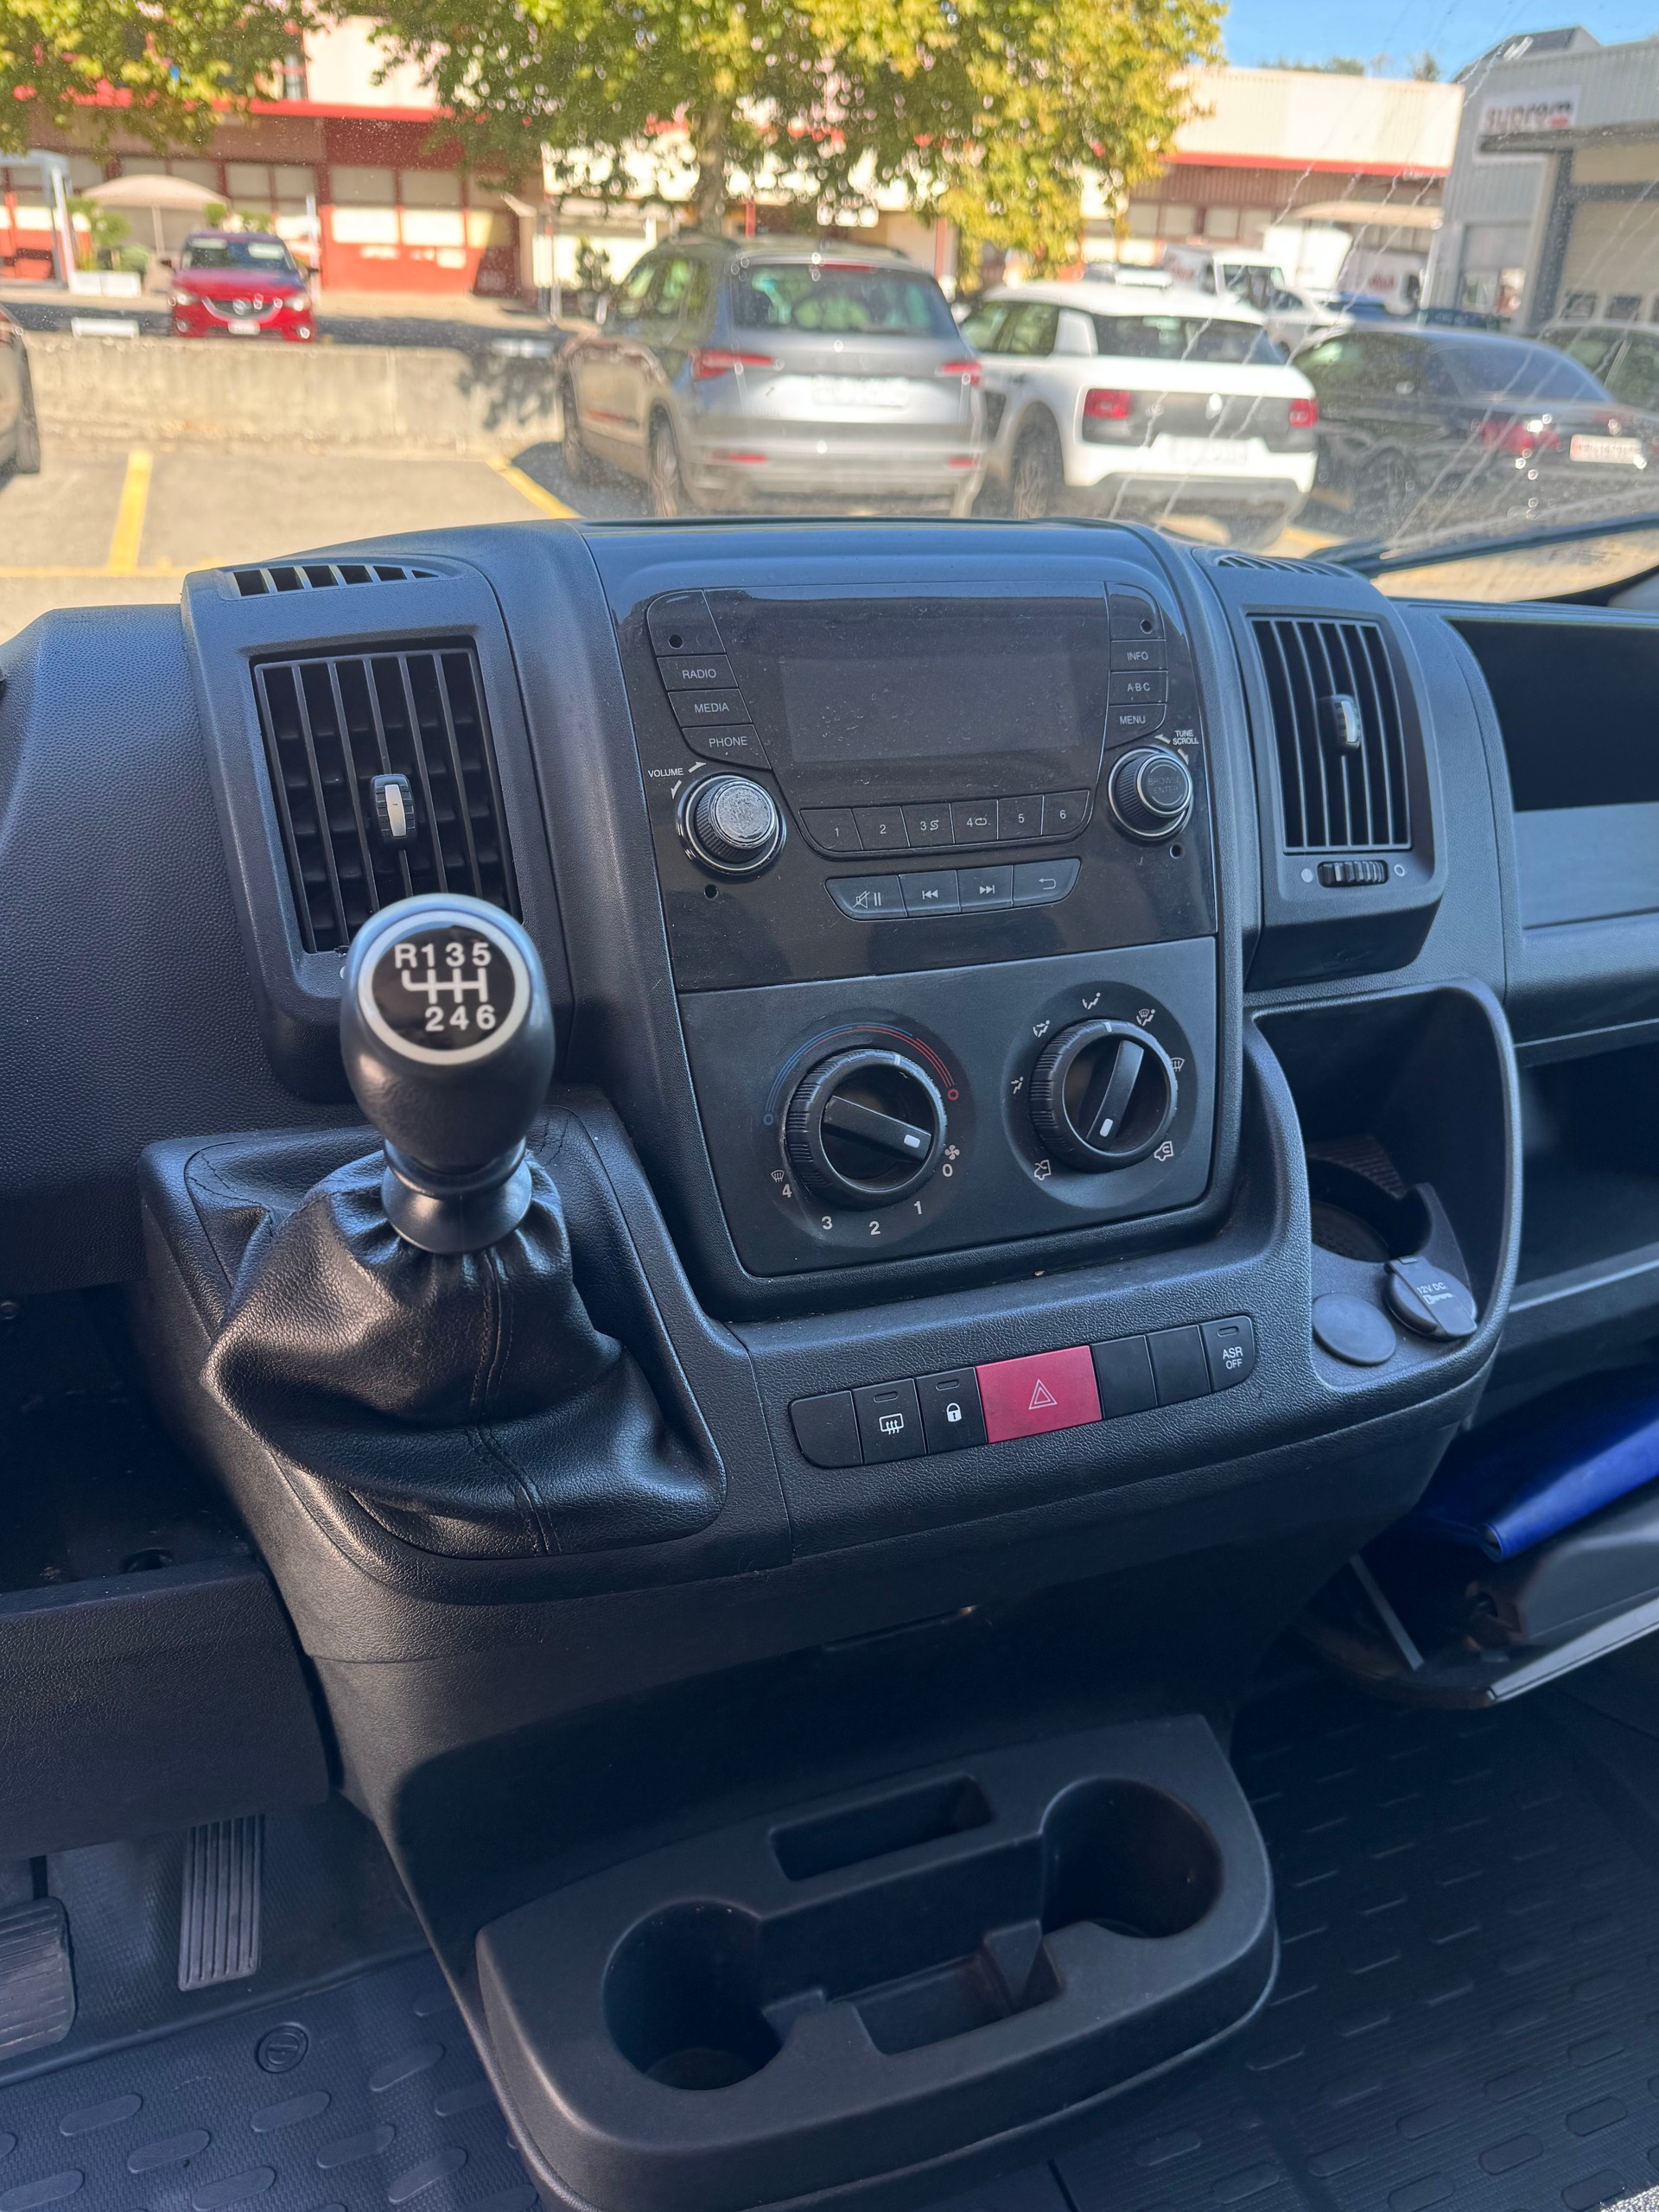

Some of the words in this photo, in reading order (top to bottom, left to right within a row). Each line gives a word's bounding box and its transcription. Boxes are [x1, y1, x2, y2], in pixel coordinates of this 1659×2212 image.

[1127, 652, 1148, 661] INFO
[682, 669, 716, 679] RADIO
[694, 702, 729, 713] MEDIA
[1119, 715, 1146, 725] MENU
[709, 736, 747, 747] PHONE
[648, 767, 683, 778] VOLUME
[1018, 814, 1025, 823] 5
[1059, 810, 1066, 819] 6
[920, 821, 927, 830] 3
[967, 818, 974, 827] 4
[835, 828, 840, 837] 1
[880, 824, 887, 834] 2
[394, 944, 417, 969] R
[421, 944, 435, 967] 1
[445, 942, 466, 967] 3
[472, 942, 492, 966] 5
[424, 1006, 445, 1032] 2
[449, 1005, 469, 1030] 4
[476, 1004, 496, 1029] 6
[942, 1164, 953, 1178] 0
[782, 1184, 792, 1198] 4
[913, 1201, 923, 1215] 1
[822, 1216, 833, 1230] 3
[868, 1221, 880, 1236] 2
[1417, 1284, 1433, 1294] 12V
[1432, 1281, 1446, 1291] DC
[1223, 1346, 1243, 1359] ASR
[1225, 1358, 1243, 1370] OFF
